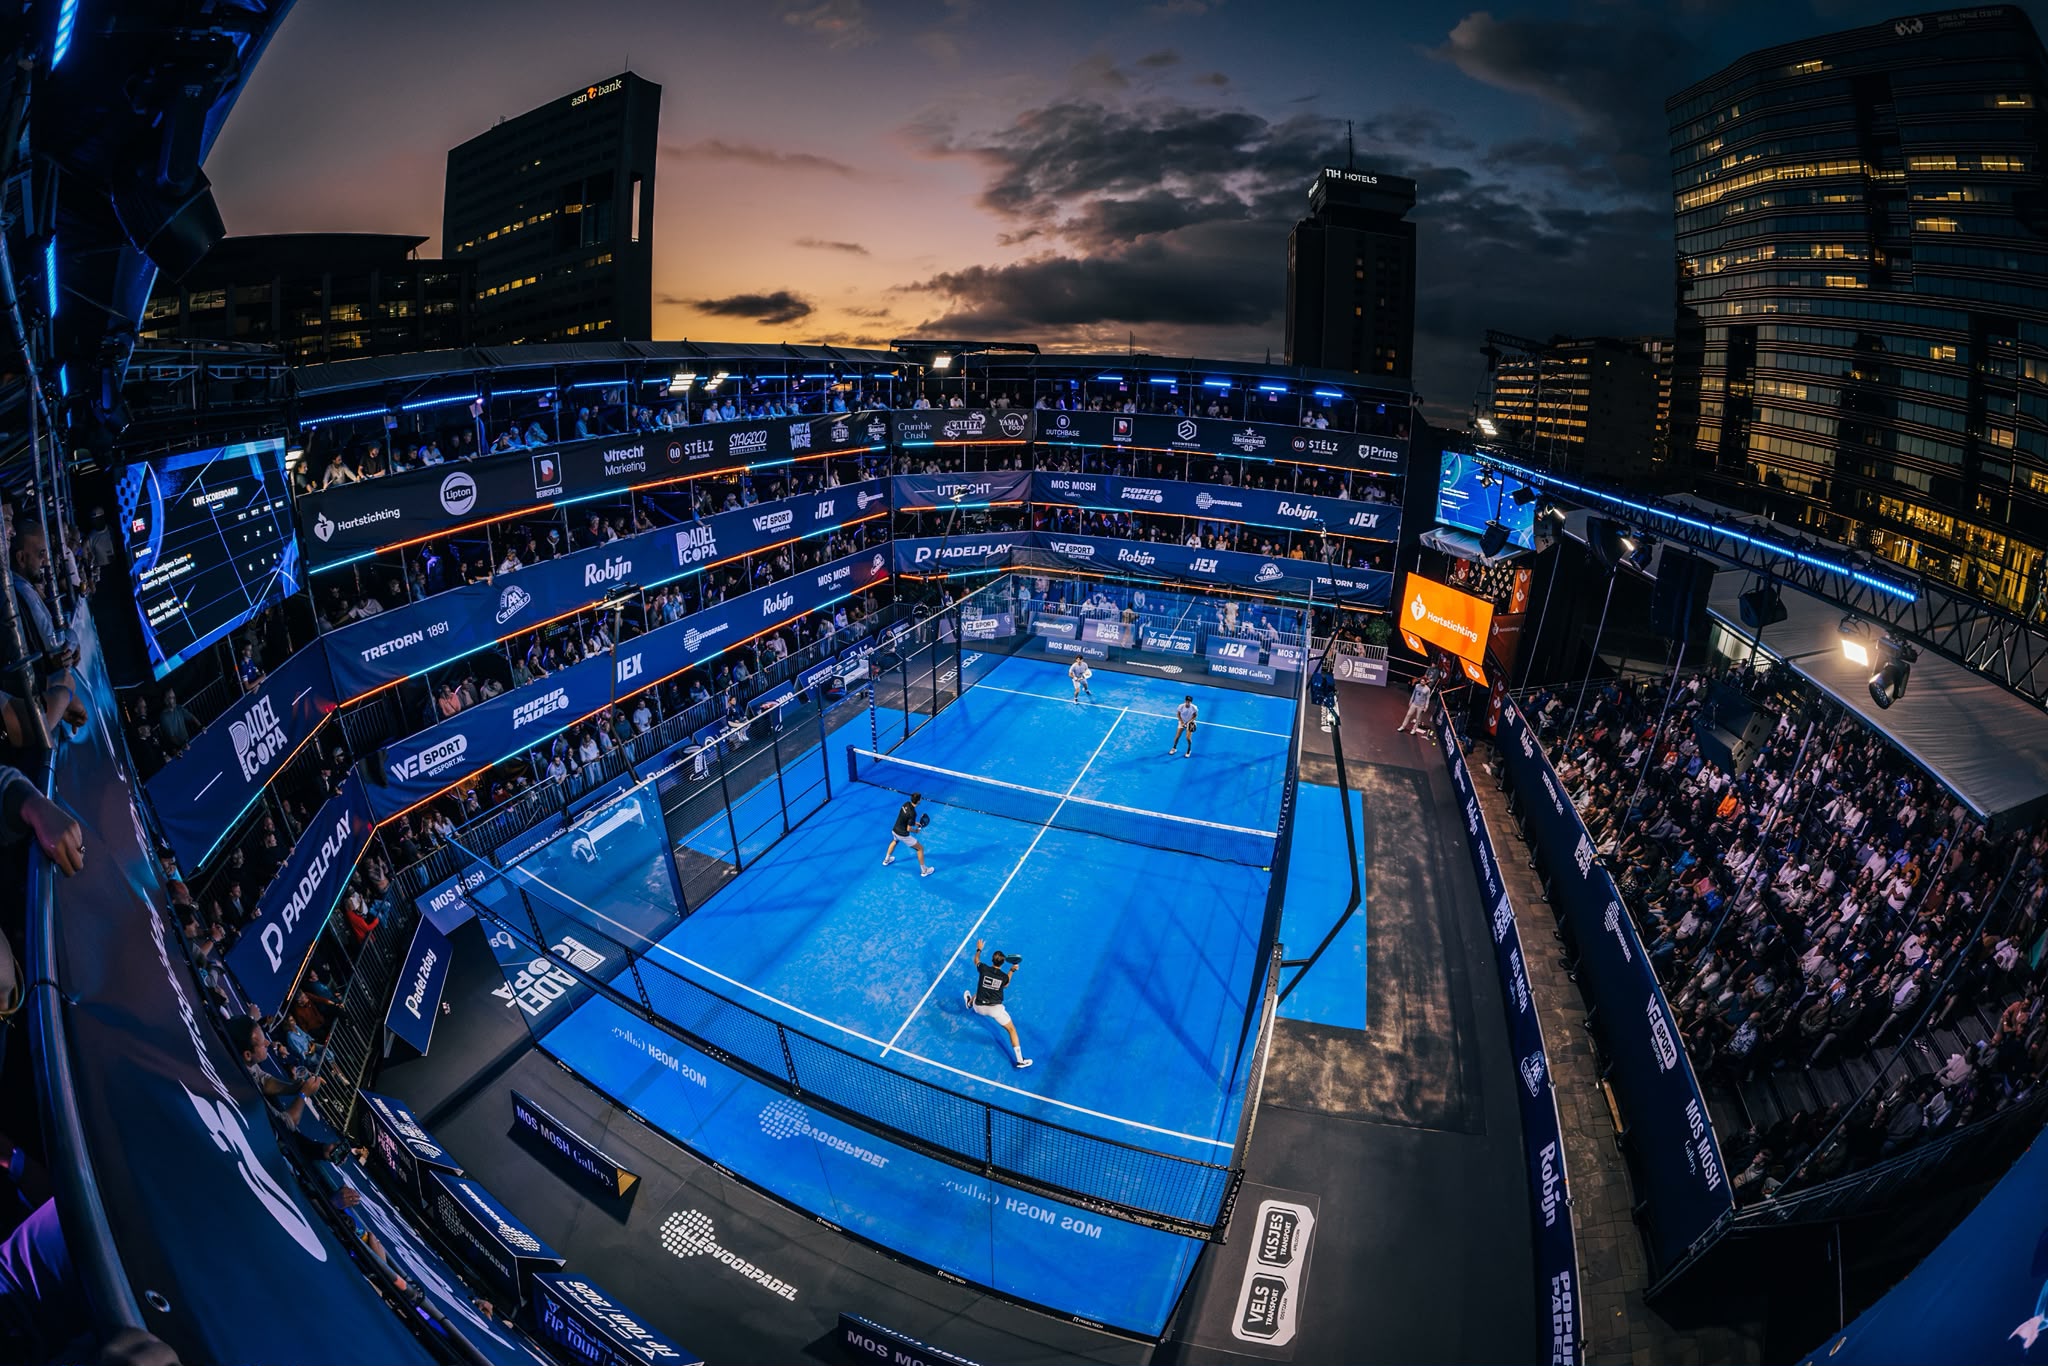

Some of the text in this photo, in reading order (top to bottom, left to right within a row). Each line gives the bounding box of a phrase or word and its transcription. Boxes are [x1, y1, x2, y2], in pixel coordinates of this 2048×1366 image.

[571, 79, 622, 106] asn bank
[1344, 172, 1378, 184] HOTELS
[729, 430, 767, 447] STAGECO
[898, 422, 932, 432] Crumble
[904, 431, 927, 440] Crush
[1046, 429, 1080, 437] DUTCHBASE
[1234, 436, 1264, 445] Heineken
[1370, 446, 1398, 459] Prins
[604, 445, 645, 462] Utrecht
[605, 461, 646, 476] Marketing
[446, 486, 472, 500] Lipton
[1051, 480, 1096, 492] MOS MOSH
[1121, 492, 1155, 500] PADEL
[1122, 487, 1162, 496] POPUP
[338, 507, 401, 532] Hartstichting
[770, 512, 790, 526] SPORT
[814, 500, 834, 520] JEX
[1277, 502, 1318, 520] Robijn
[1350, 512, 1380, 528] JEX
[676, 526, 716, 560] PADEL
[682, 543, 718, 564] COPA
[935, 544, 1012, 558] PADELPLAY
[1068, 545, 1091, 554] SPORT
[1118, 548, 1156, 566] Robijn
[1190, 558, 1218, 573] JEX
[585, 556, 632, 586] Robijn
[818, 566, 850, 587] MOS MOSH
[1316, 577, 1370, 590] TREORN 1891
[763, 592, 794, 616] Robijn
[1427, 612, 1478, 643] Hartstichting
[361, 620, 450, 662] TRETORN 1891
[1048, 641, 1062, 650] MOS
[1064, 644, 1082, 652] MOSH
[1147, 638, 1190, 650] FIP TOUR 2026
[1219, 643, 1247, 658] JEX
[1278, 649, 1294, 658] MOS
[617, 653, 642, 683] JEX
[1212, 664, 1227, 672] MOS
[1228, 666, 1248, 676] MOSH
[513, 688, 565, 720] POPUP
[513, 701, 560, 730] PADEL
[228, 694, 280, 772] PADEL
[249, 727, 288, 777] COPA
[424, 738, 462, 765] SPORT
[428, 755, 466, 778] WESPORT.NL
[282, 809, 351, 934] PADELPLAY
[430, 889, 456, 912] MOS
[454, 870, 486, 895] MOSH
[405, 948, 437, 1020] Padel 2day
[1510, 948, 1528, 1014] MOS MOSH
[1656, 1024, 1674, 1062] SPORT
[516, 1105, 614, 1187] MOS MOSH Gallery.
[1686, 1098, 1720, 1192] MOS MOSH
[1684, 1140, 1696, 1176] Gallery.
[1540, 1140, 1560, 1227] Robijn
[1264, 1214, 1284, 1260] KISJES
[1280, 1222, 1292, 1256] TRANSPORT
[674, 1224, 798, 1302] ALLESVOORPADEL
[556, 1280, 632, 1340] CUPRA
[1248, 1286, 1270, 1324] VELS
[1266, 1288, 1280, 1326] TRANSPORT
[568, 1281, 680, 1357] FIP TOUR 2026
[544, 1310, 600, 1362] FIP TOUR
[847, 1329, 888, 1358] MOS
